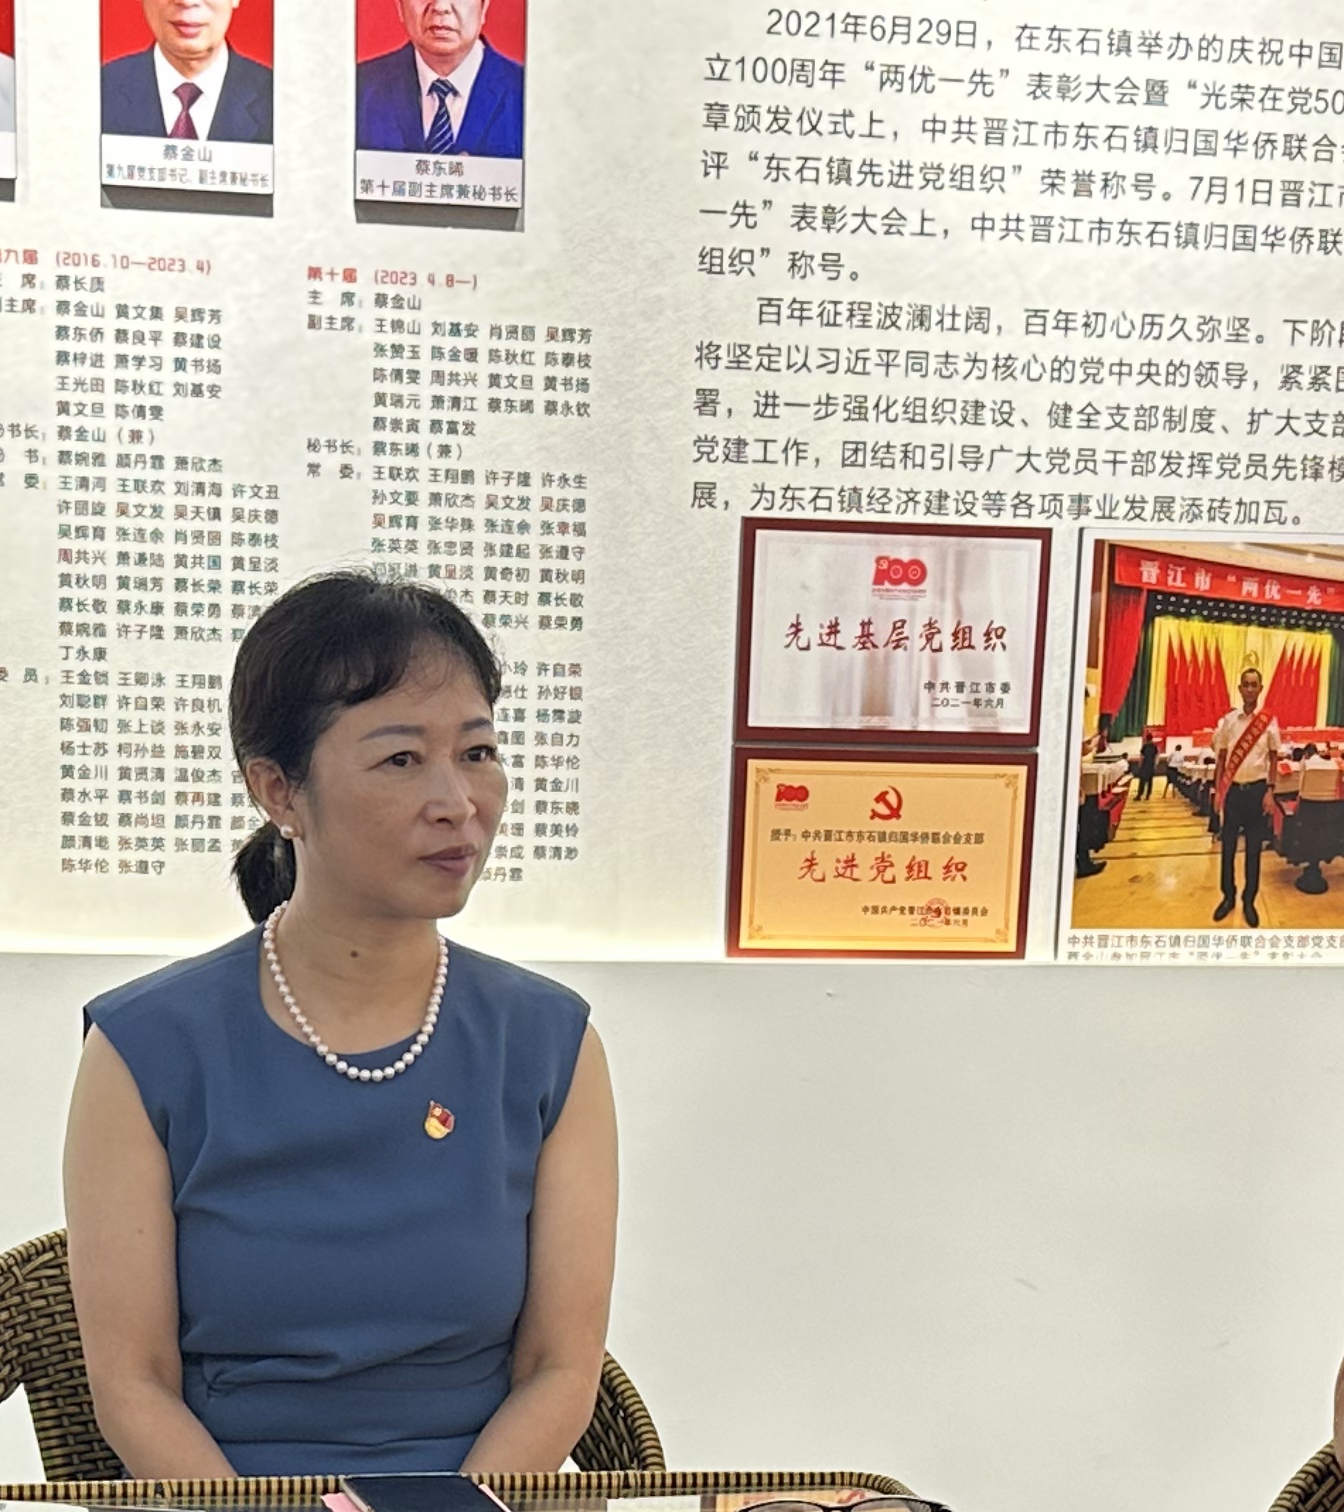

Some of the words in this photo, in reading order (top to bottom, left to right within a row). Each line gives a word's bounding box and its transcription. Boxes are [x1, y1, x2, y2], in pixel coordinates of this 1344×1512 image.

[162, 144, 213, 162] 蔡金山
[783, 613, 1008, 653] 先进基层党组织
[797, 850, 969, 885] 先进党组织
